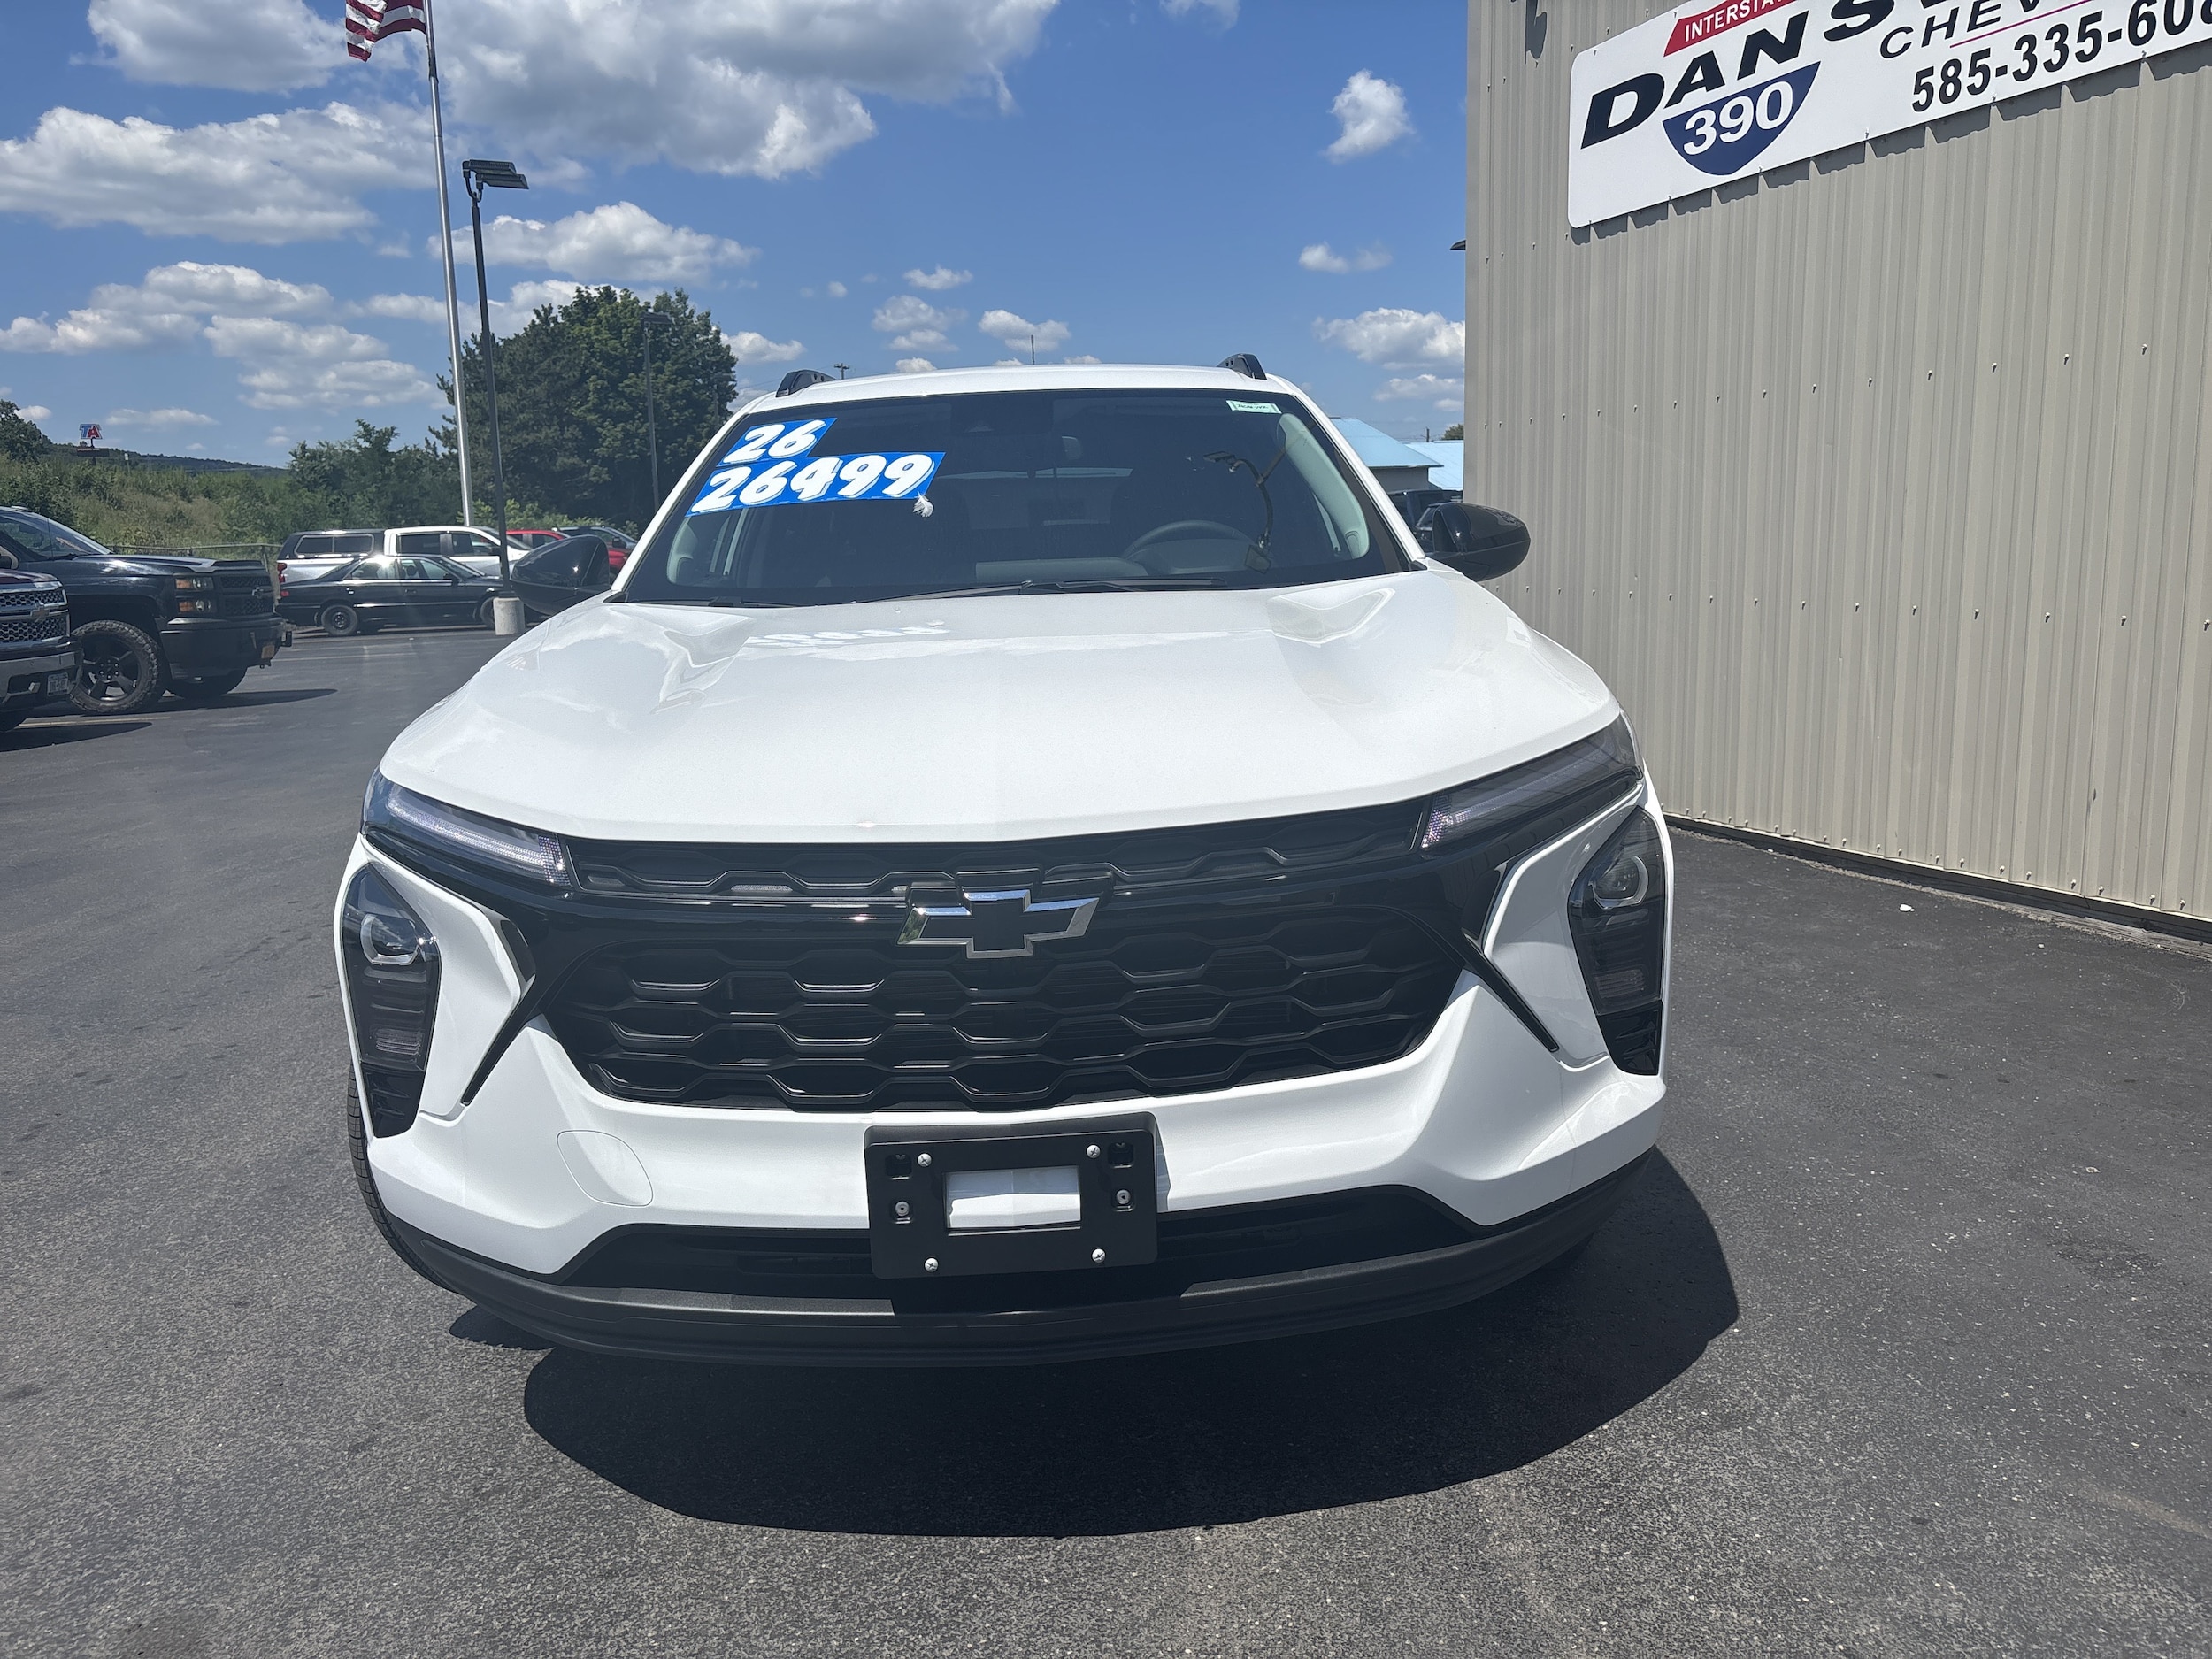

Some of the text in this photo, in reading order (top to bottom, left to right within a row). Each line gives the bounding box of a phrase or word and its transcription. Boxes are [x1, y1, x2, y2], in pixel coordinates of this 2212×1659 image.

[1911, 0, 2212, 112] 585-335-60
[1683, 81, 1793, 156] 390
[80, 424, 102, 439] TA
[722, 419, 827, 464] 26
[691, 453, 935, 513] 26499
